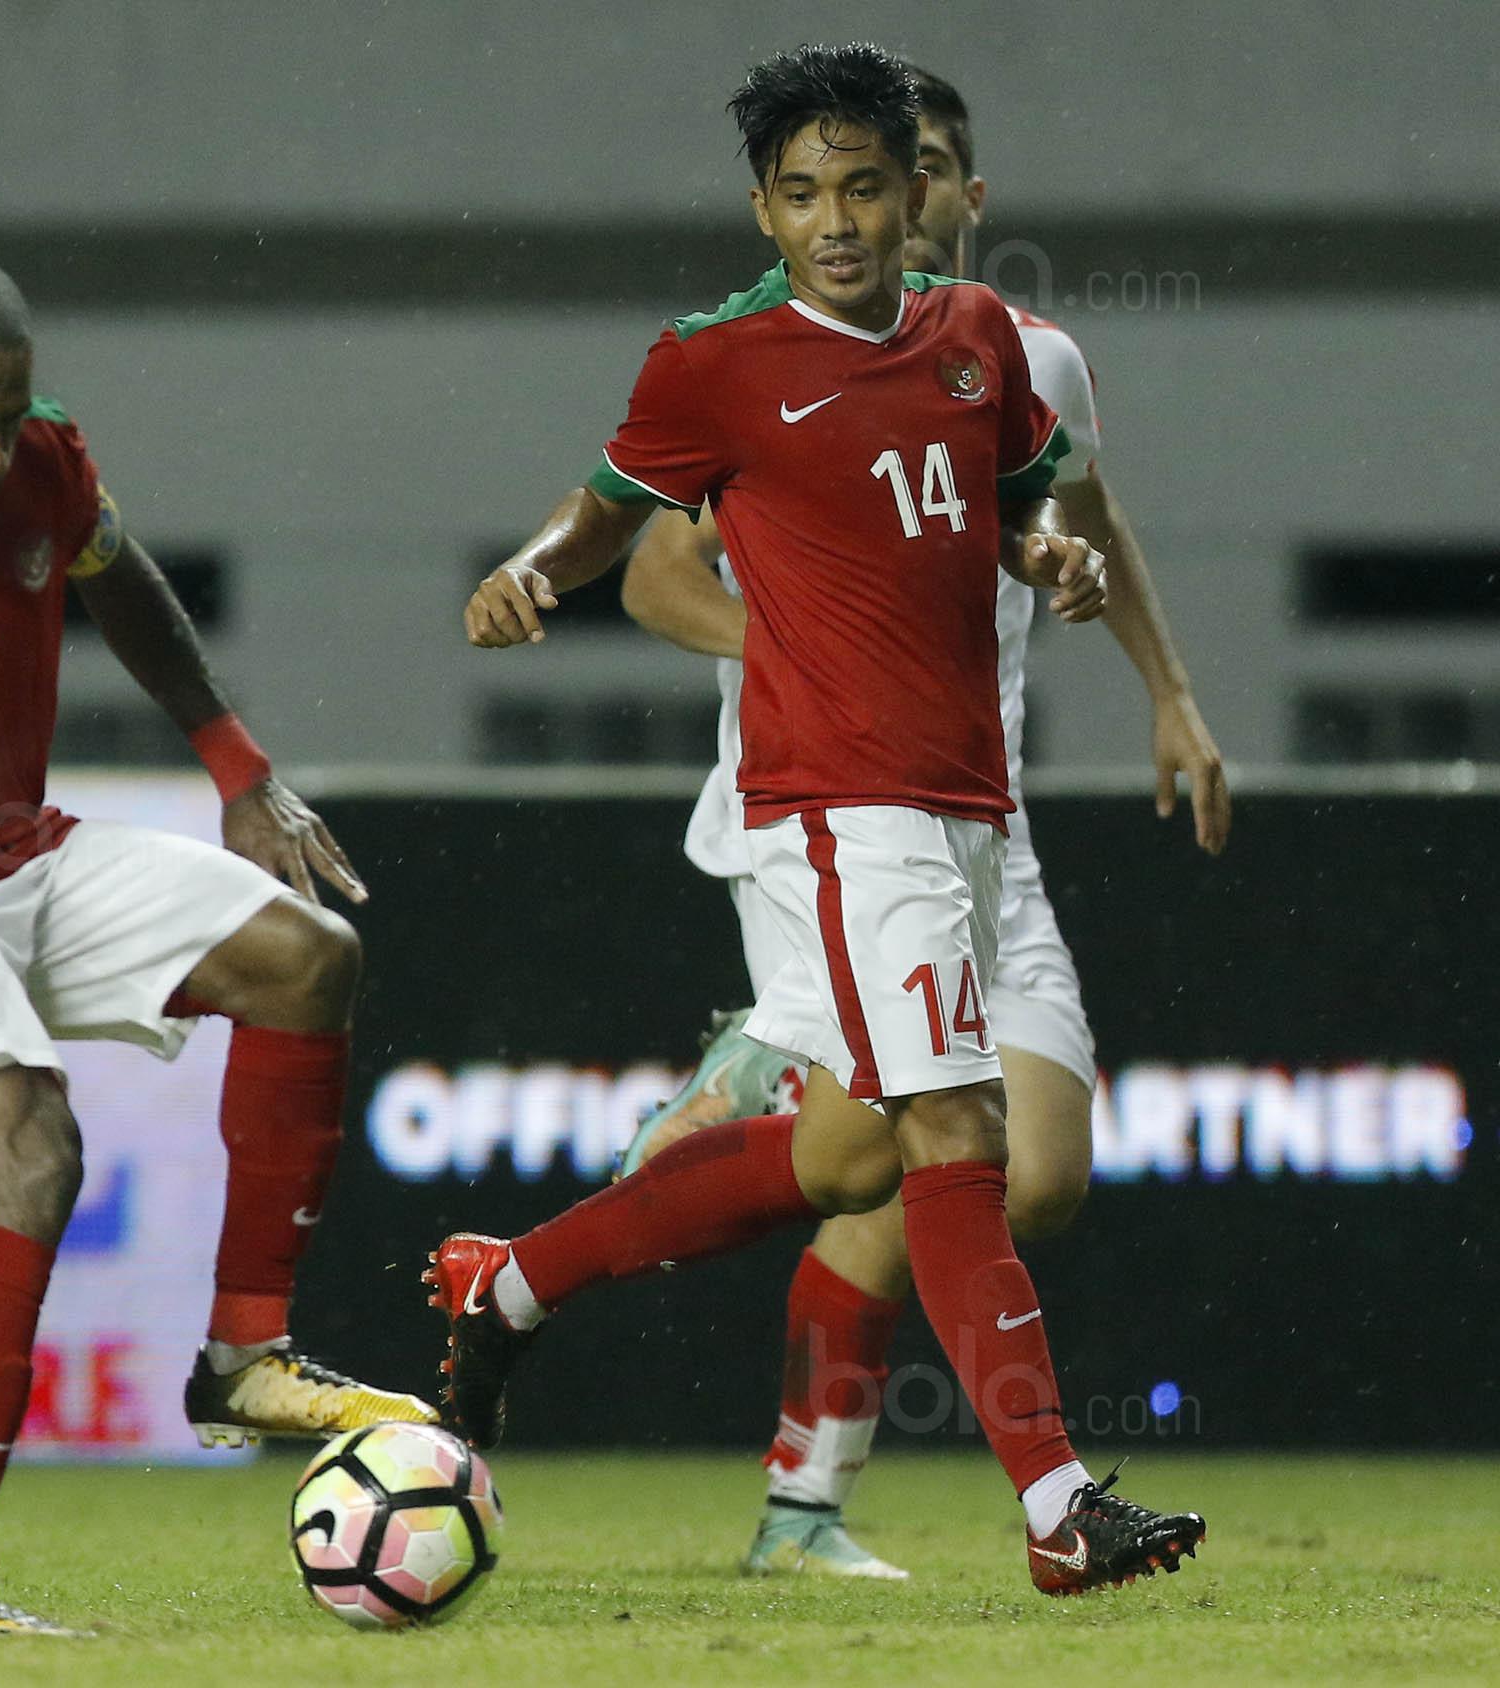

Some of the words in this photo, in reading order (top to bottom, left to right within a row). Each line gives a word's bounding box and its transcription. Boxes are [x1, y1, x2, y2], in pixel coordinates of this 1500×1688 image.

[870, 442, 967, 538] 14
[901, 959, 988, 1056] 14
[366, 1060, 697, 1183] OFFIC
[1090, 1058, 1466, 1182] ARTNER
